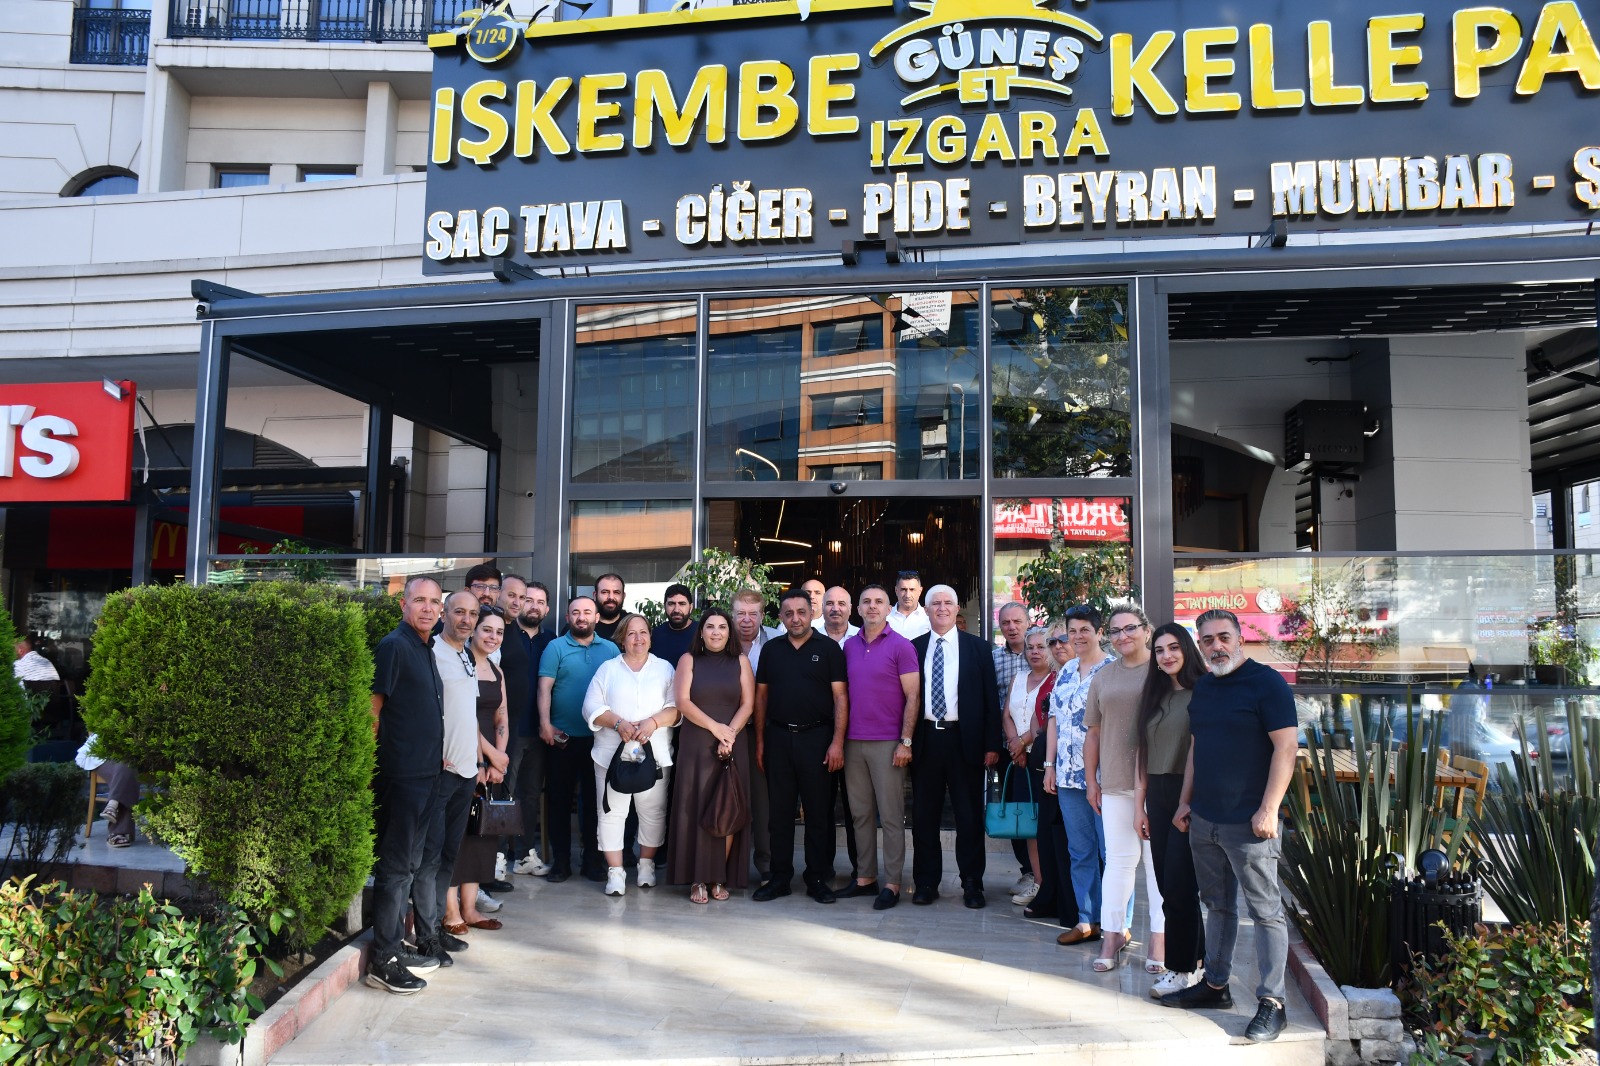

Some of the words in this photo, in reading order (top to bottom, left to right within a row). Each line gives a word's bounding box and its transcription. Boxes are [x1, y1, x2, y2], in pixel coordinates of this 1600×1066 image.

[475, 28, 507, 45] 7/24
[893, 22, 1084, 83] GÜNEŞ
[1110, 13, 1430, 118] KELLE
[1453, 0, 1600, 99] PA
[431, 53, 861, 165] İŞKEMBE
[958, 66, 1019, 103] ET
[870, 107, 1110, 168] IZGARA
[425, 206, 512, 262] SAC
[519, 199, 629, 254] TAVA
[674, 180, 813, 246] CİĞER
[862, 171, 971, 235] PİDE
[1023, 165, 1217, 228] BEYRAN
[1270, 152, 1516, 217] MUMBAR
